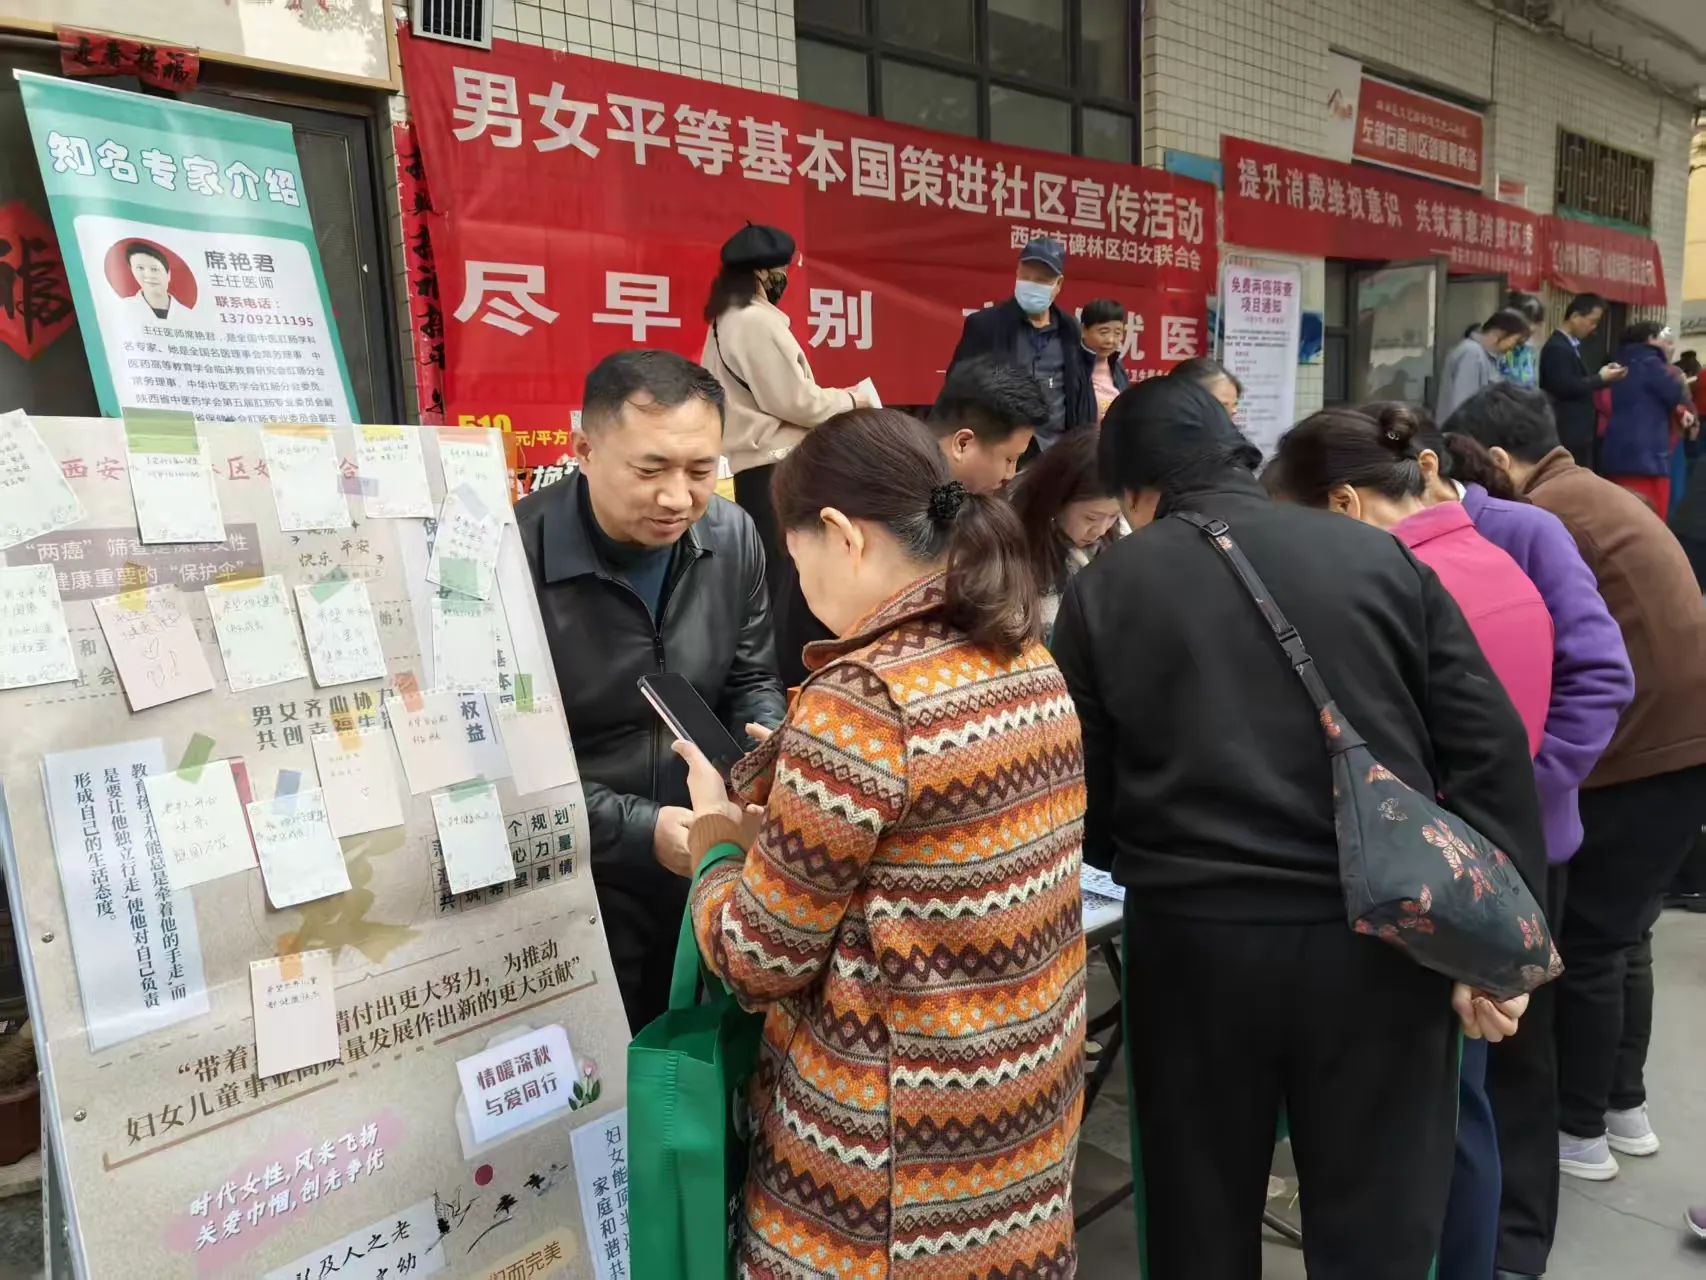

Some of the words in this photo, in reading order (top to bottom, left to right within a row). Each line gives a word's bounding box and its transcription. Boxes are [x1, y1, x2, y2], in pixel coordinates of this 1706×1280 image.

[47, 130, 301, 207] 知名专家介绍
[452, 66, 1205, 245] 男女平等基本国策进社区宣传活动
[1237, 156, 1402, 228] 提升消费维权意识
[204, 250, 276, 273] 席艳君
[209, 273, 275, 290] 主任医师
[1231, 276, 1293, 297] 免费两癌筛查
[219, 312, 315, 328] 13709211195
[454, 260, 873, 351] 尽早别
[1240, 296, 1282, 314] 项目通知
[61, 458, 125, 481] 西安
[299, 550, 333, 568] 快乐
[340, 539, 370, 558] 平安
[78, 639, 97, 657] 和
[459, 700, 486, 743] 权益
[74, 772, 117, 921] 形成自己的生活态度。
[513, 833, 572, 864] 心力量
[103, 767, 161, 1008] 是要让他独立行走，使他对自己负责
[476, 1044, 553, 1091] 情暖深秋
[485, 1071, 558, 1117] 与爱同行
